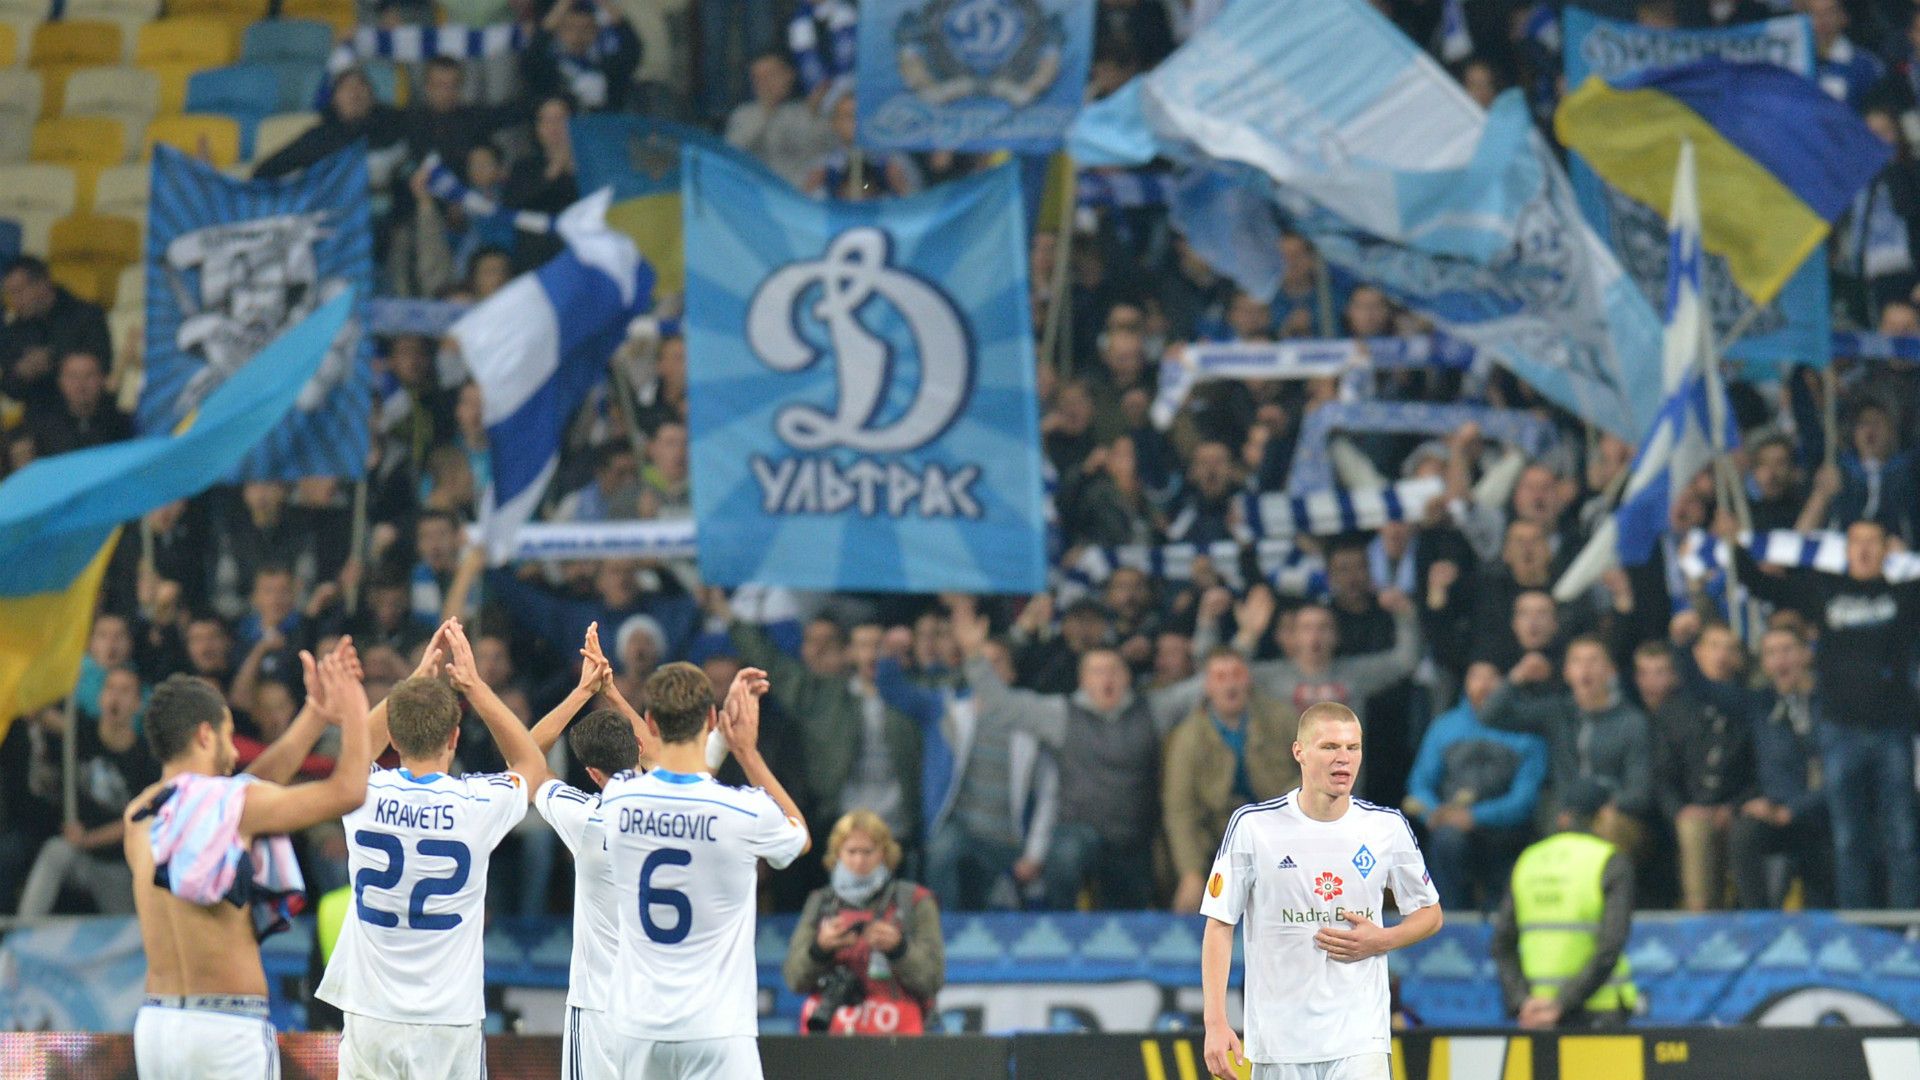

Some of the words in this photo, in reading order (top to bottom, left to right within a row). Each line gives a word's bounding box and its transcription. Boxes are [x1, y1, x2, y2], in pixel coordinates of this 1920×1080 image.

[751, 456, 982, 518] УЛЬТРАС
[375, 798, 455, 830] KRAVETS
[619, 808, 718, 842] DRAGOVIC
[355, 829, 471, 931] 22
[639, 848, 692, 945] 6
[1283, 907, 1331, 923] Nadra
[1336, 906, 1374, 922] Bnk
[1655, 1041, 1689, 1064] SM
